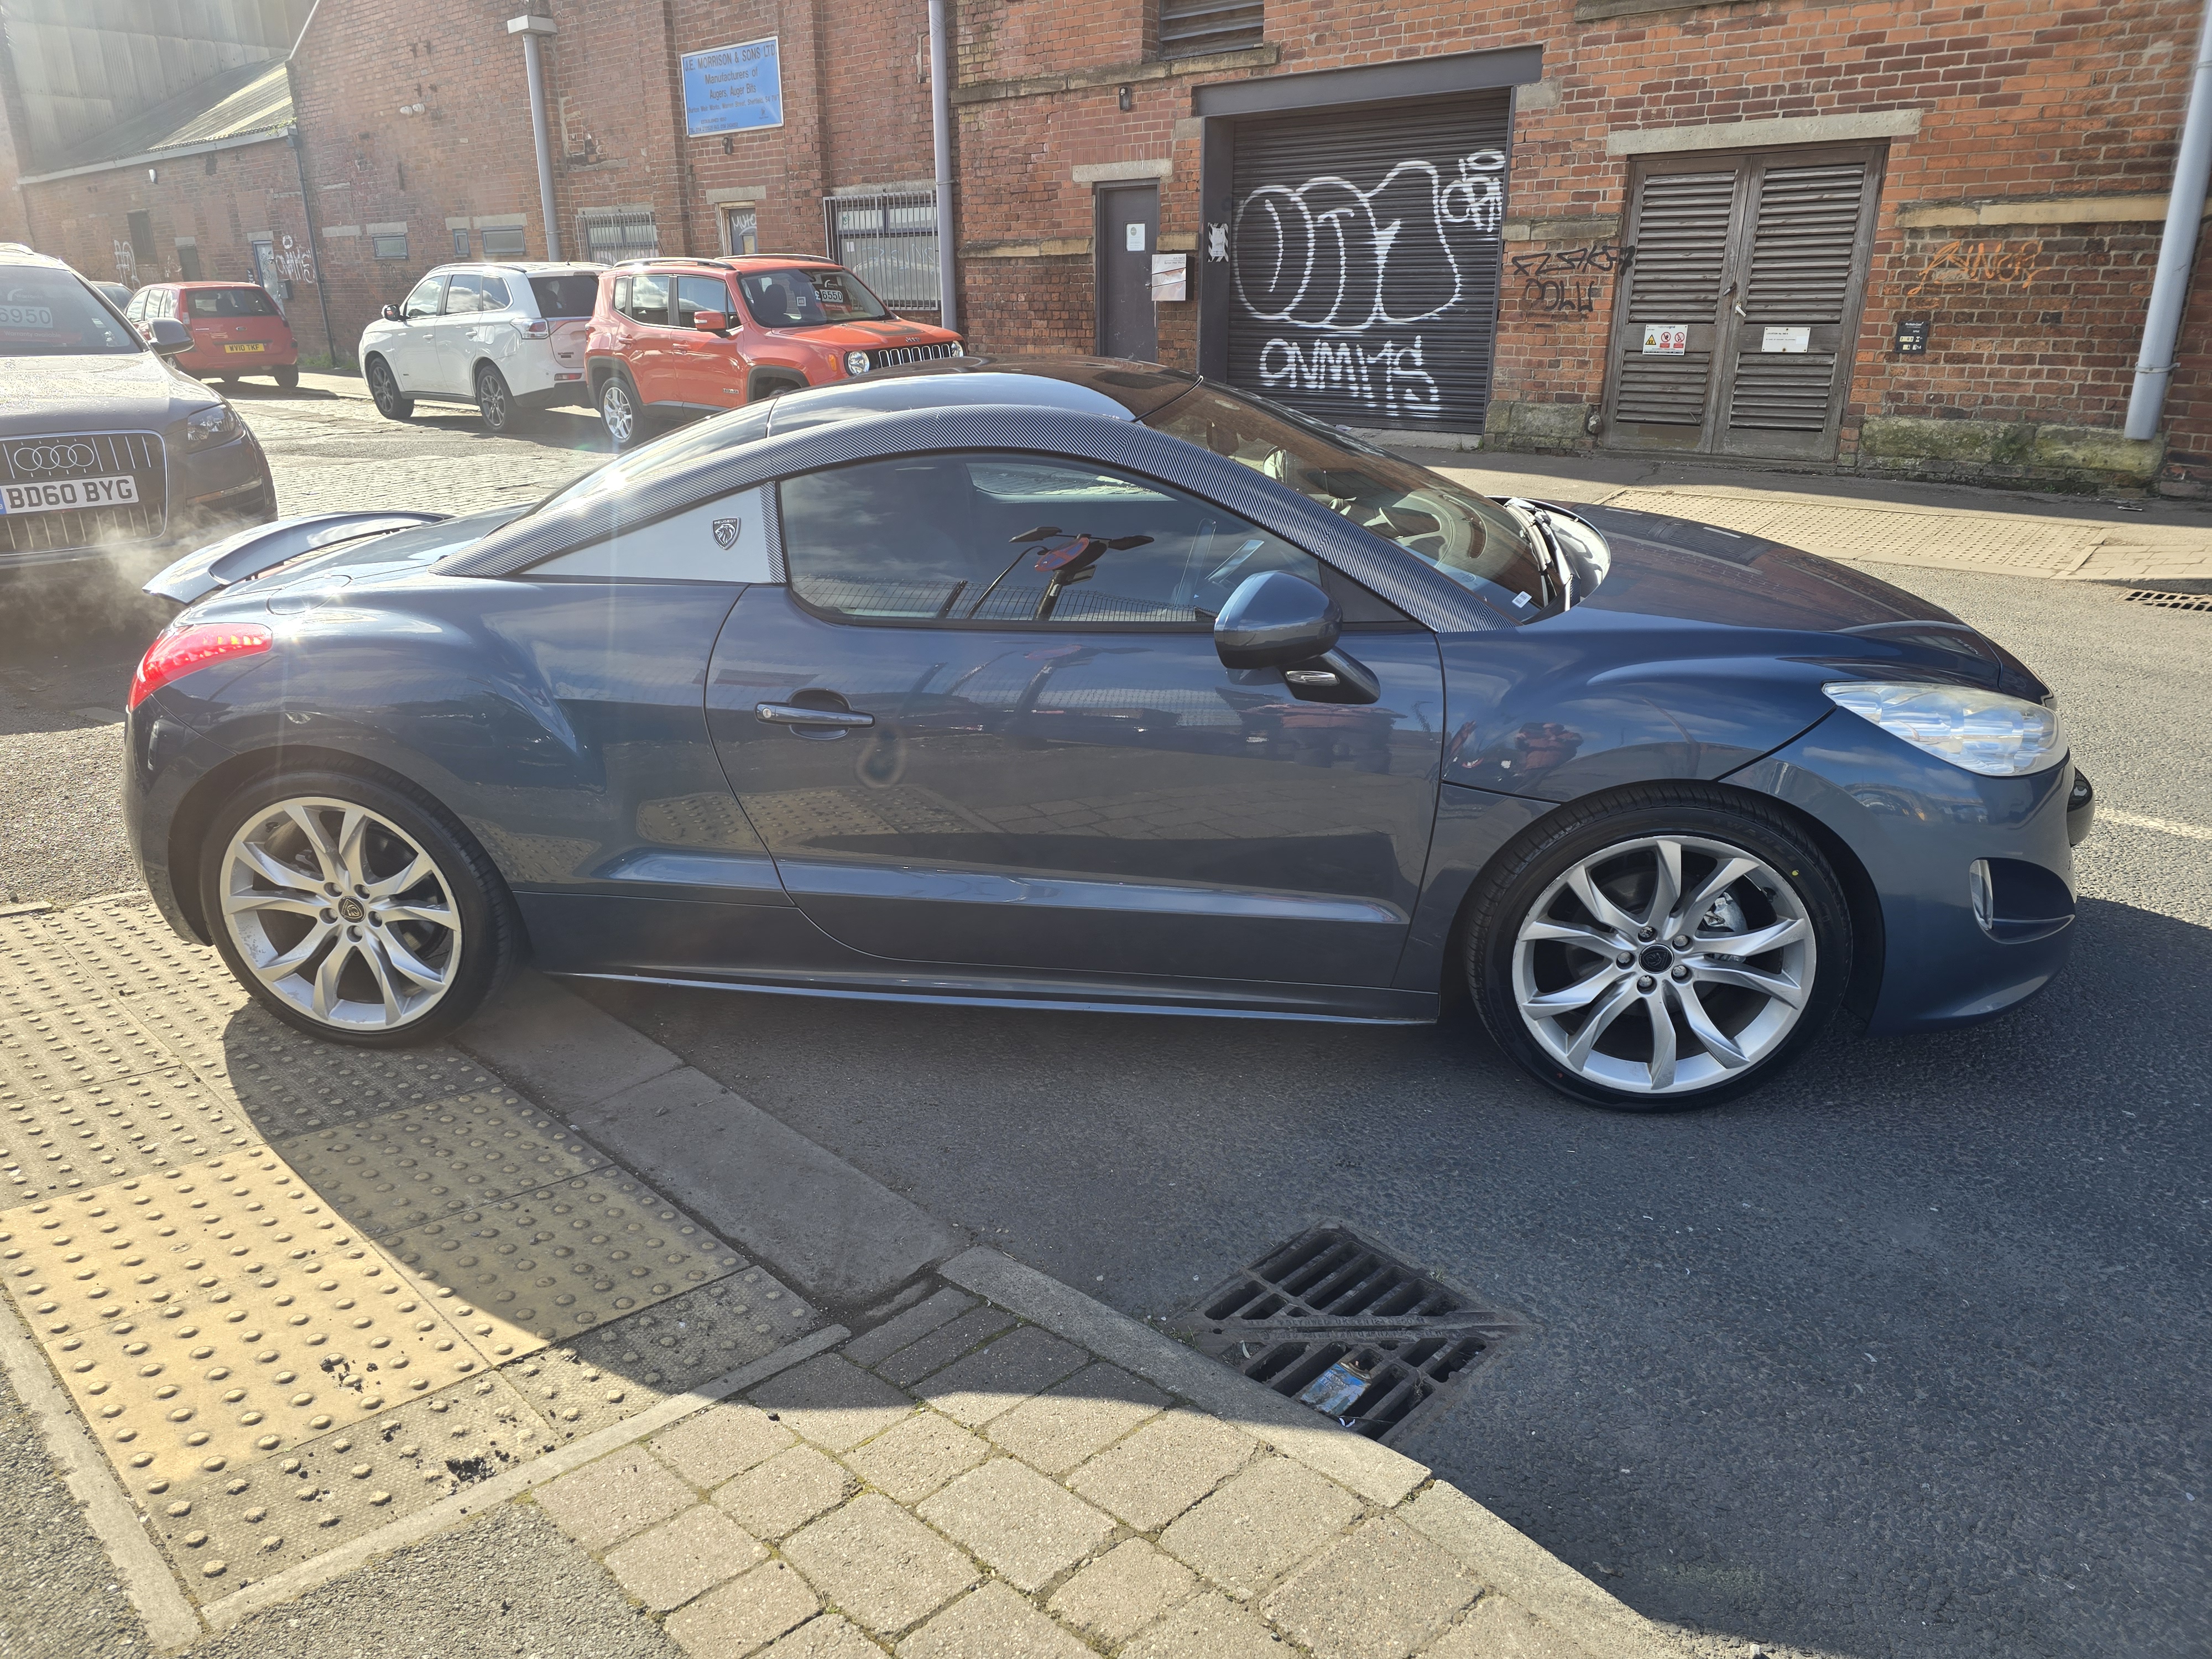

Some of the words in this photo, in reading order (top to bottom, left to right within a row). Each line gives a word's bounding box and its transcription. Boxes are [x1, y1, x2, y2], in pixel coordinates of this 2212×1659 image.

[685, 59, 696, 71] J.E.
[697, 53, 732, 69] MORRISON
[734, 51, 739, 64] &
[742, 47, 761, 62] SONS
[705, 70, 749, 85] Manufacturers
[752, 66, 758, 77] of
[709, 89, 728, 101] Augers,
[730, 86, 745, 98] Auger
[747, 84, 757, 93] Bits
[6, 483, 77, 509] BD60
[82, 479, 133, 503] BYG
